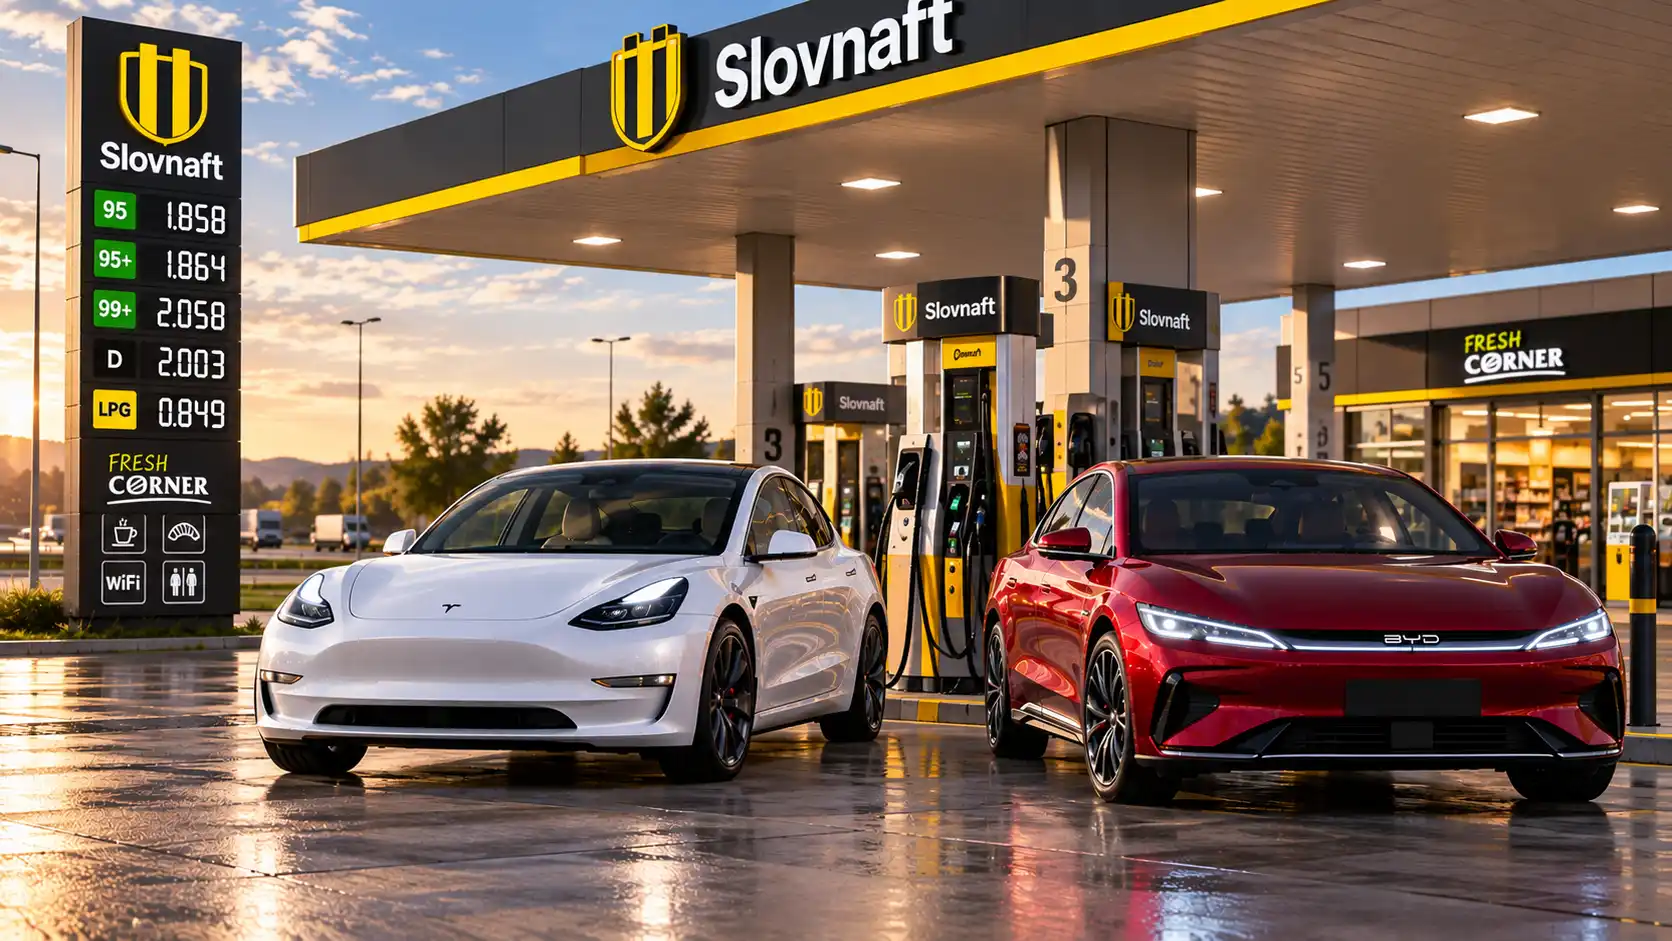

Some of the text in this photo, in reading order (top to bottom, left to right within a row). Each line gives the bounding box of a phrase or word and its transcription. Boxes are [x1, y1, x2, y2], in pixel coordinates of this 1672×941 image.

[715, 0, 953, 109] Slovnaft
[100, 141, 223, 180] Slovnaft
[103, 200, 226, 235] 95 1.858
[98, 249, 226, 282] 95+ 1.864
[1054, 257, 1077, 302] 3
[98, 297, 225, 331] 99+ 2.058
[925, 296, 996, 320] Slovnaft
[1139, 308, 1190, 330] Slovnaft
[1464, 330, 1522, 354] FRESH
[107, 347, 225, 379] D 2.003
[1294, 366, 1303, 384] 5
[1464, 347, 1564, 375] CORNER
[1318, 362, 1331, 391] 5
[99, 397, 225, 429] LPG 0.849
[839, 396, 885, 412] Slovnaft
[764, 428, 782, 461] 3
[109, 453, 168, 472] FRESH
[108, 475, 209, 495] CORNER
[106, 574, 141, 591] WiFi
[1384, 634, 1440, 644] BYD
